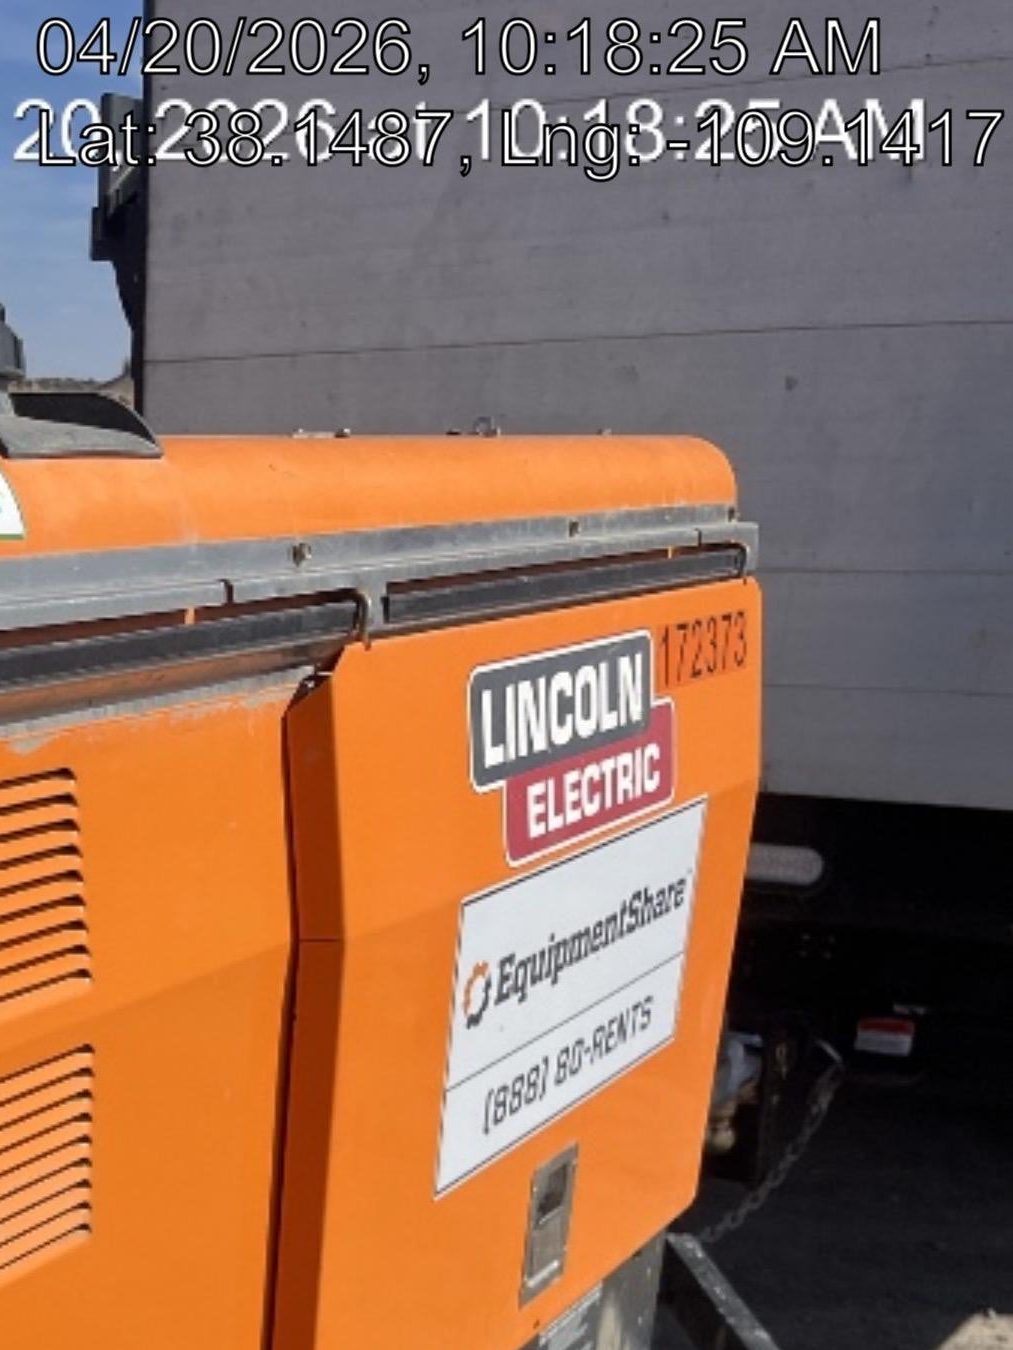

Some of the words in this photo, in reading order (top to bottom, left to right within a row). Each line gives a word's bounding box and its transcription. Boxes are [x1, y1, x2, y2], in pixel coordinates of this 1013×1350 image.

[659, 609, 748, 688] 172373
[480, 652, 644, 769] LINCOLN
[526, 741, 662, 839] ELECTRIC
[493, 876, 687, 1006] EquipmentShare
[482, 1052, 550, 1135] (888)
[553, 995, 654, 1087] 80-RENTS
